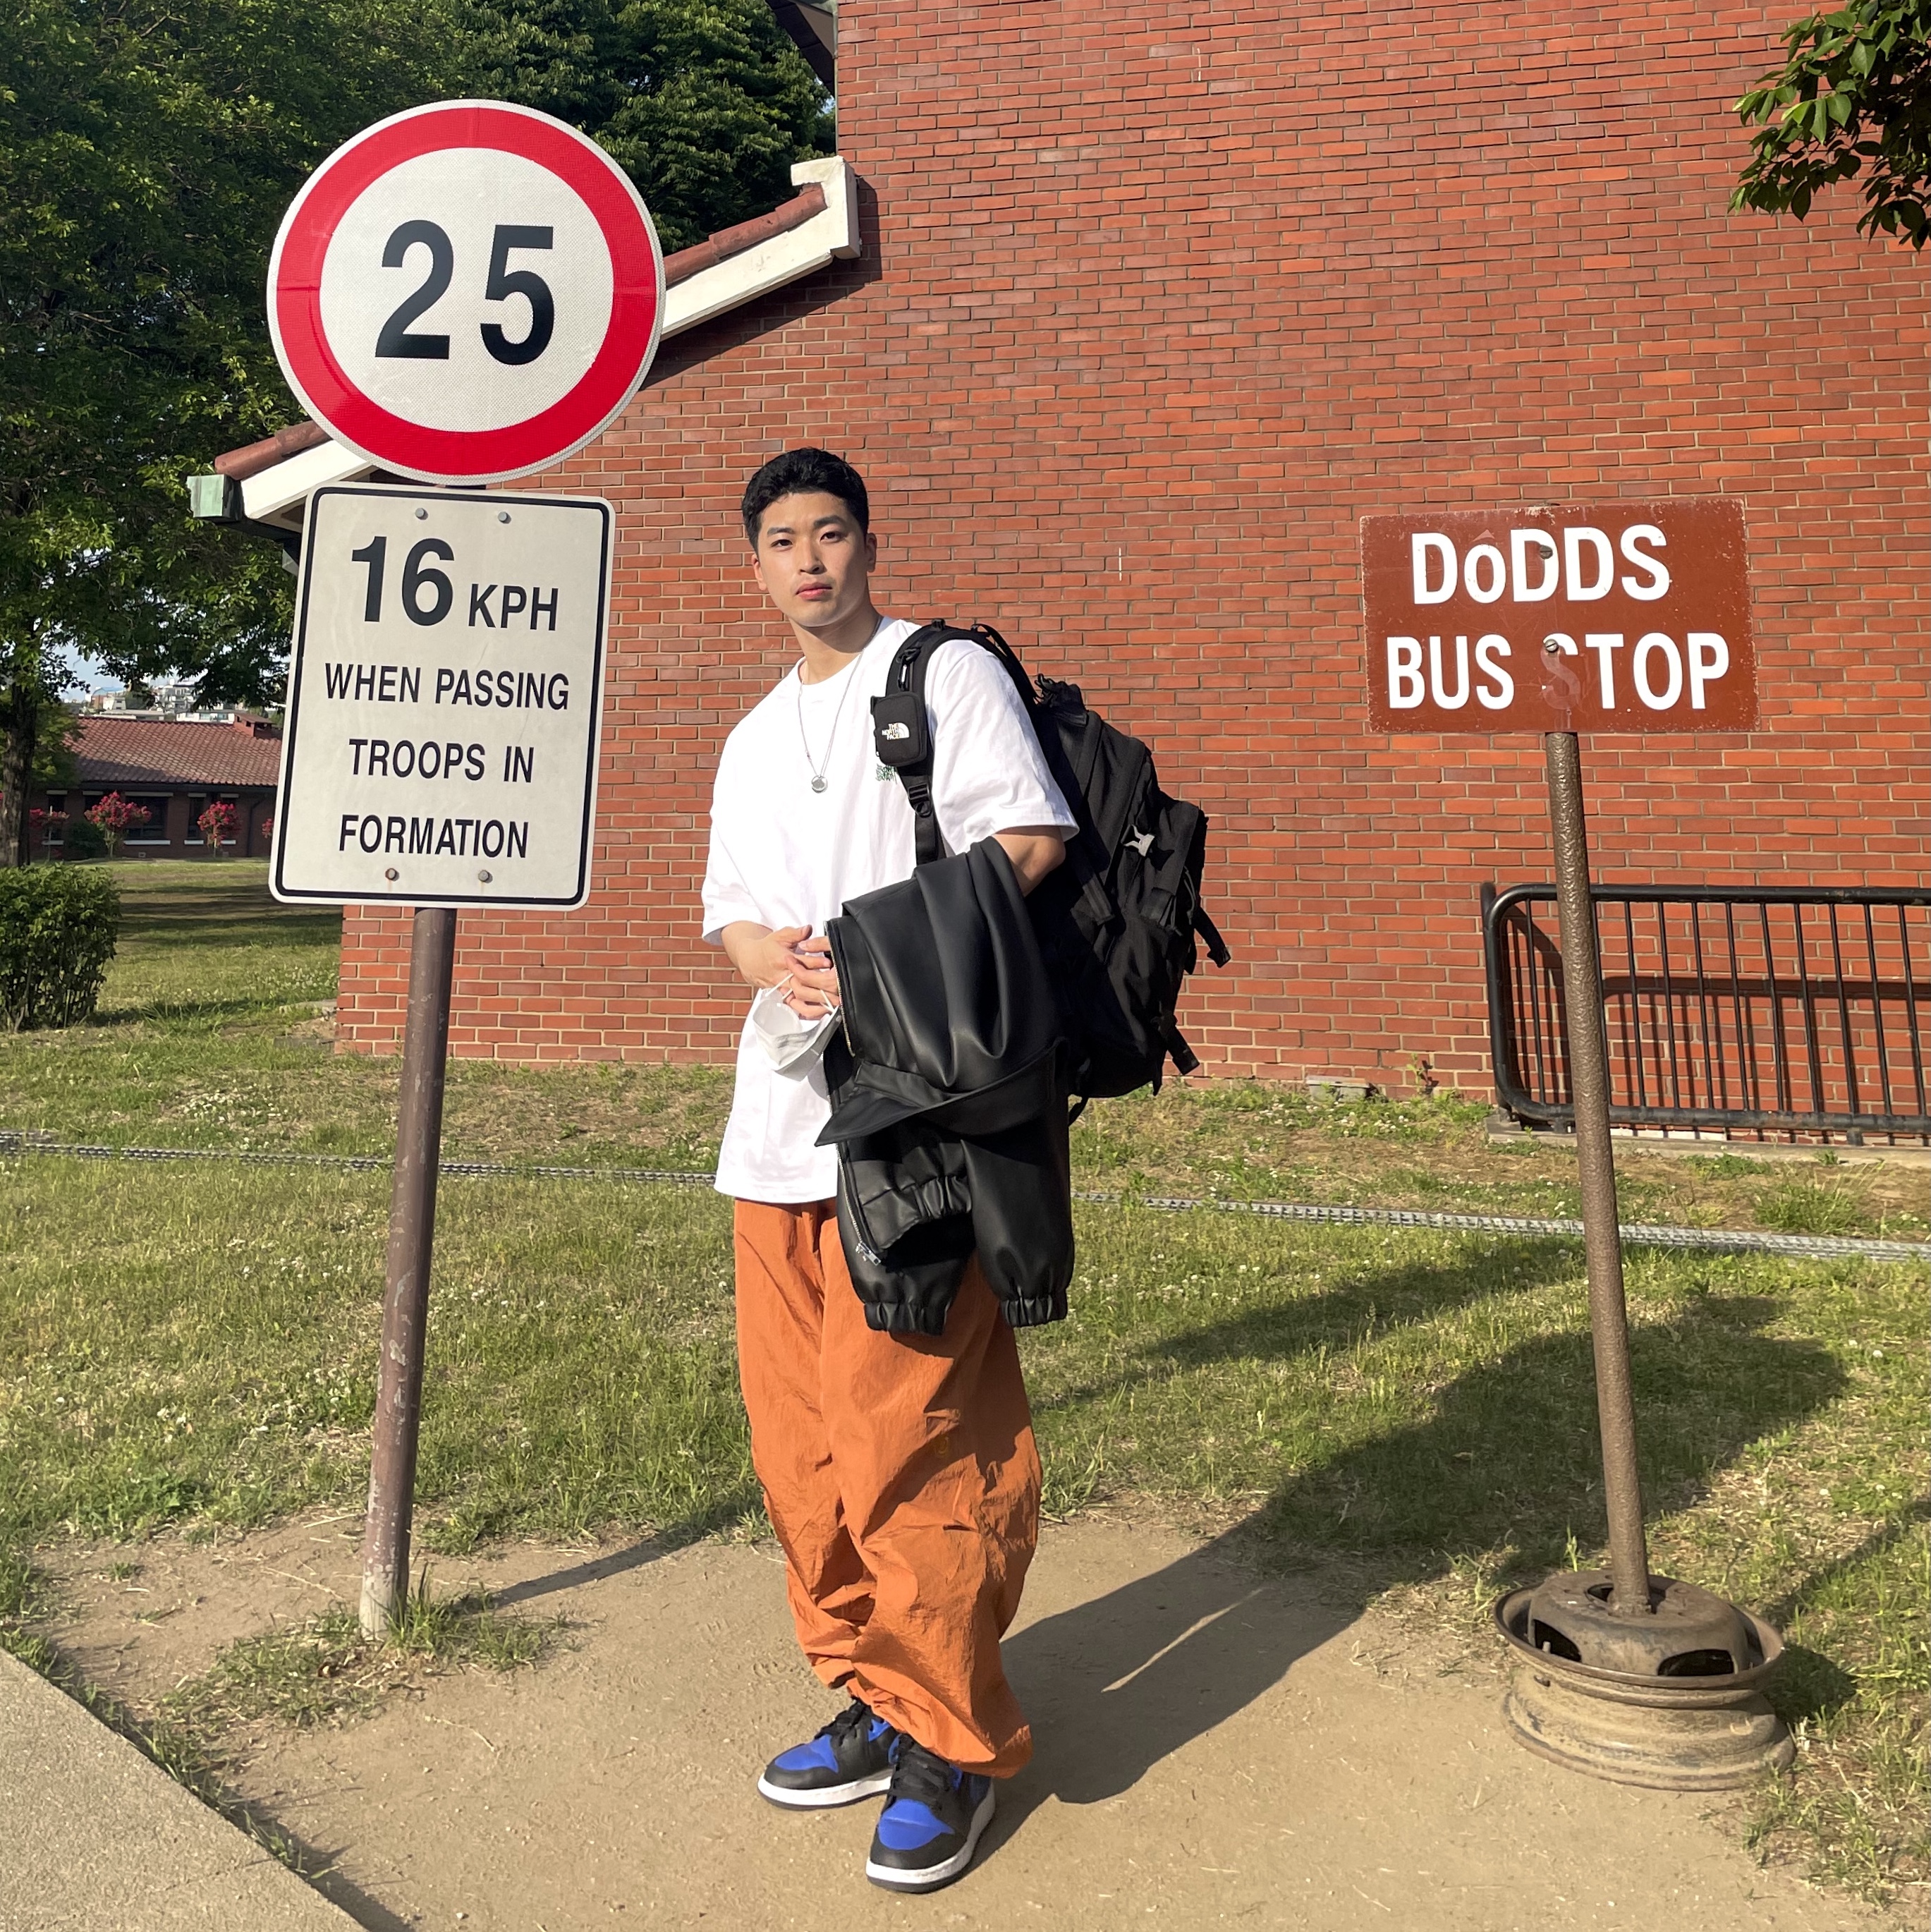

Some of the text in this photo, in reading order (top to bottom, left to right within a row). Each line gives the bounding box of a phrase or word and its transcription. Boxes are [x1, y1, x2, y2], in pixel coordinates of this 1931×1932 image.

[375, 220, 554, 365] 25
[352, 536, 558, 631] 16 KPH
[1412, 525, 1671, 604] DoDDS
[326, 663, 569, 710] WHEN PASSING
[1387, 634, 1514, 710] BUS
[349, 739, 534, 783] TROOPS IN
[340, 815, 529, 858] FORMATION
